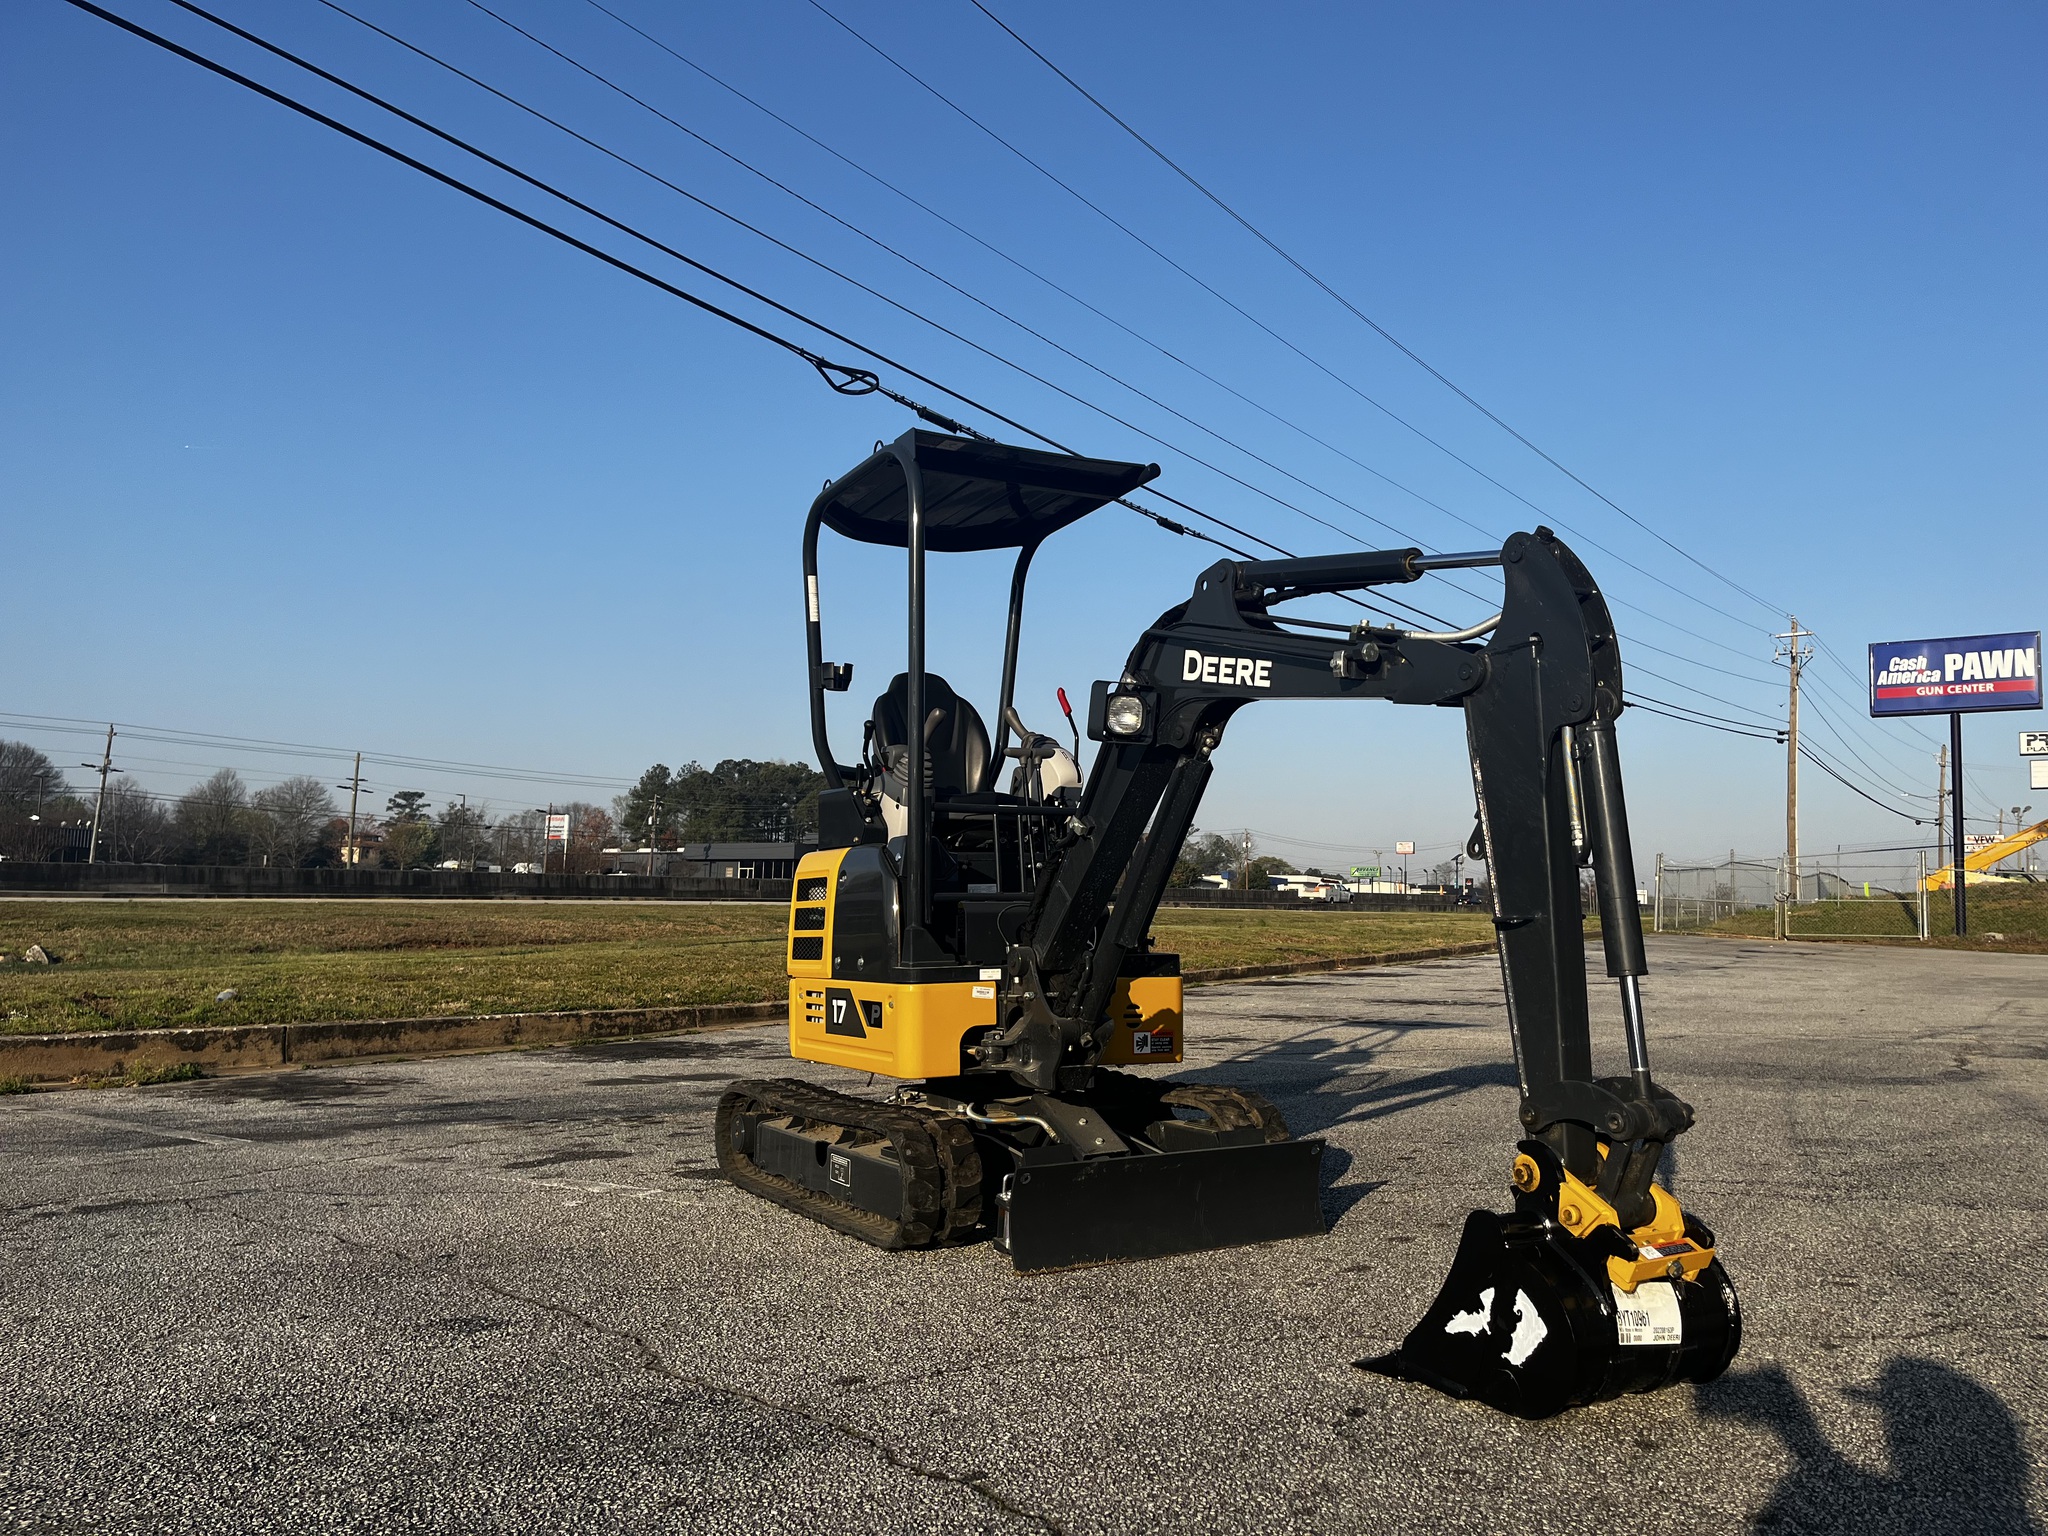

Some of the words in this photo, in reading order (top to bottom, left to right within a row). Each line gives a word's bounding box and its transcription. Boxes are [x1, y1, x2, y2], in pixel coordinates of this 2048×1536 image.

[1182, 649, 1272, 688] DEERE
[1889, 656, 1927, 671] Cash
[1944, 648, 2035, 682] PAWN
[1877, 669, 1941, 686] America
[1916, 686, 1944, 696] GUN
[1947, 683, 1995, 695] CENTER
[1974, 835, 1995, 844] VFW
[832, 999, 847, 1024] 17
[870, 1004, 881, 1025] P
[1653, 1334, 1666, 1342] JOHN
